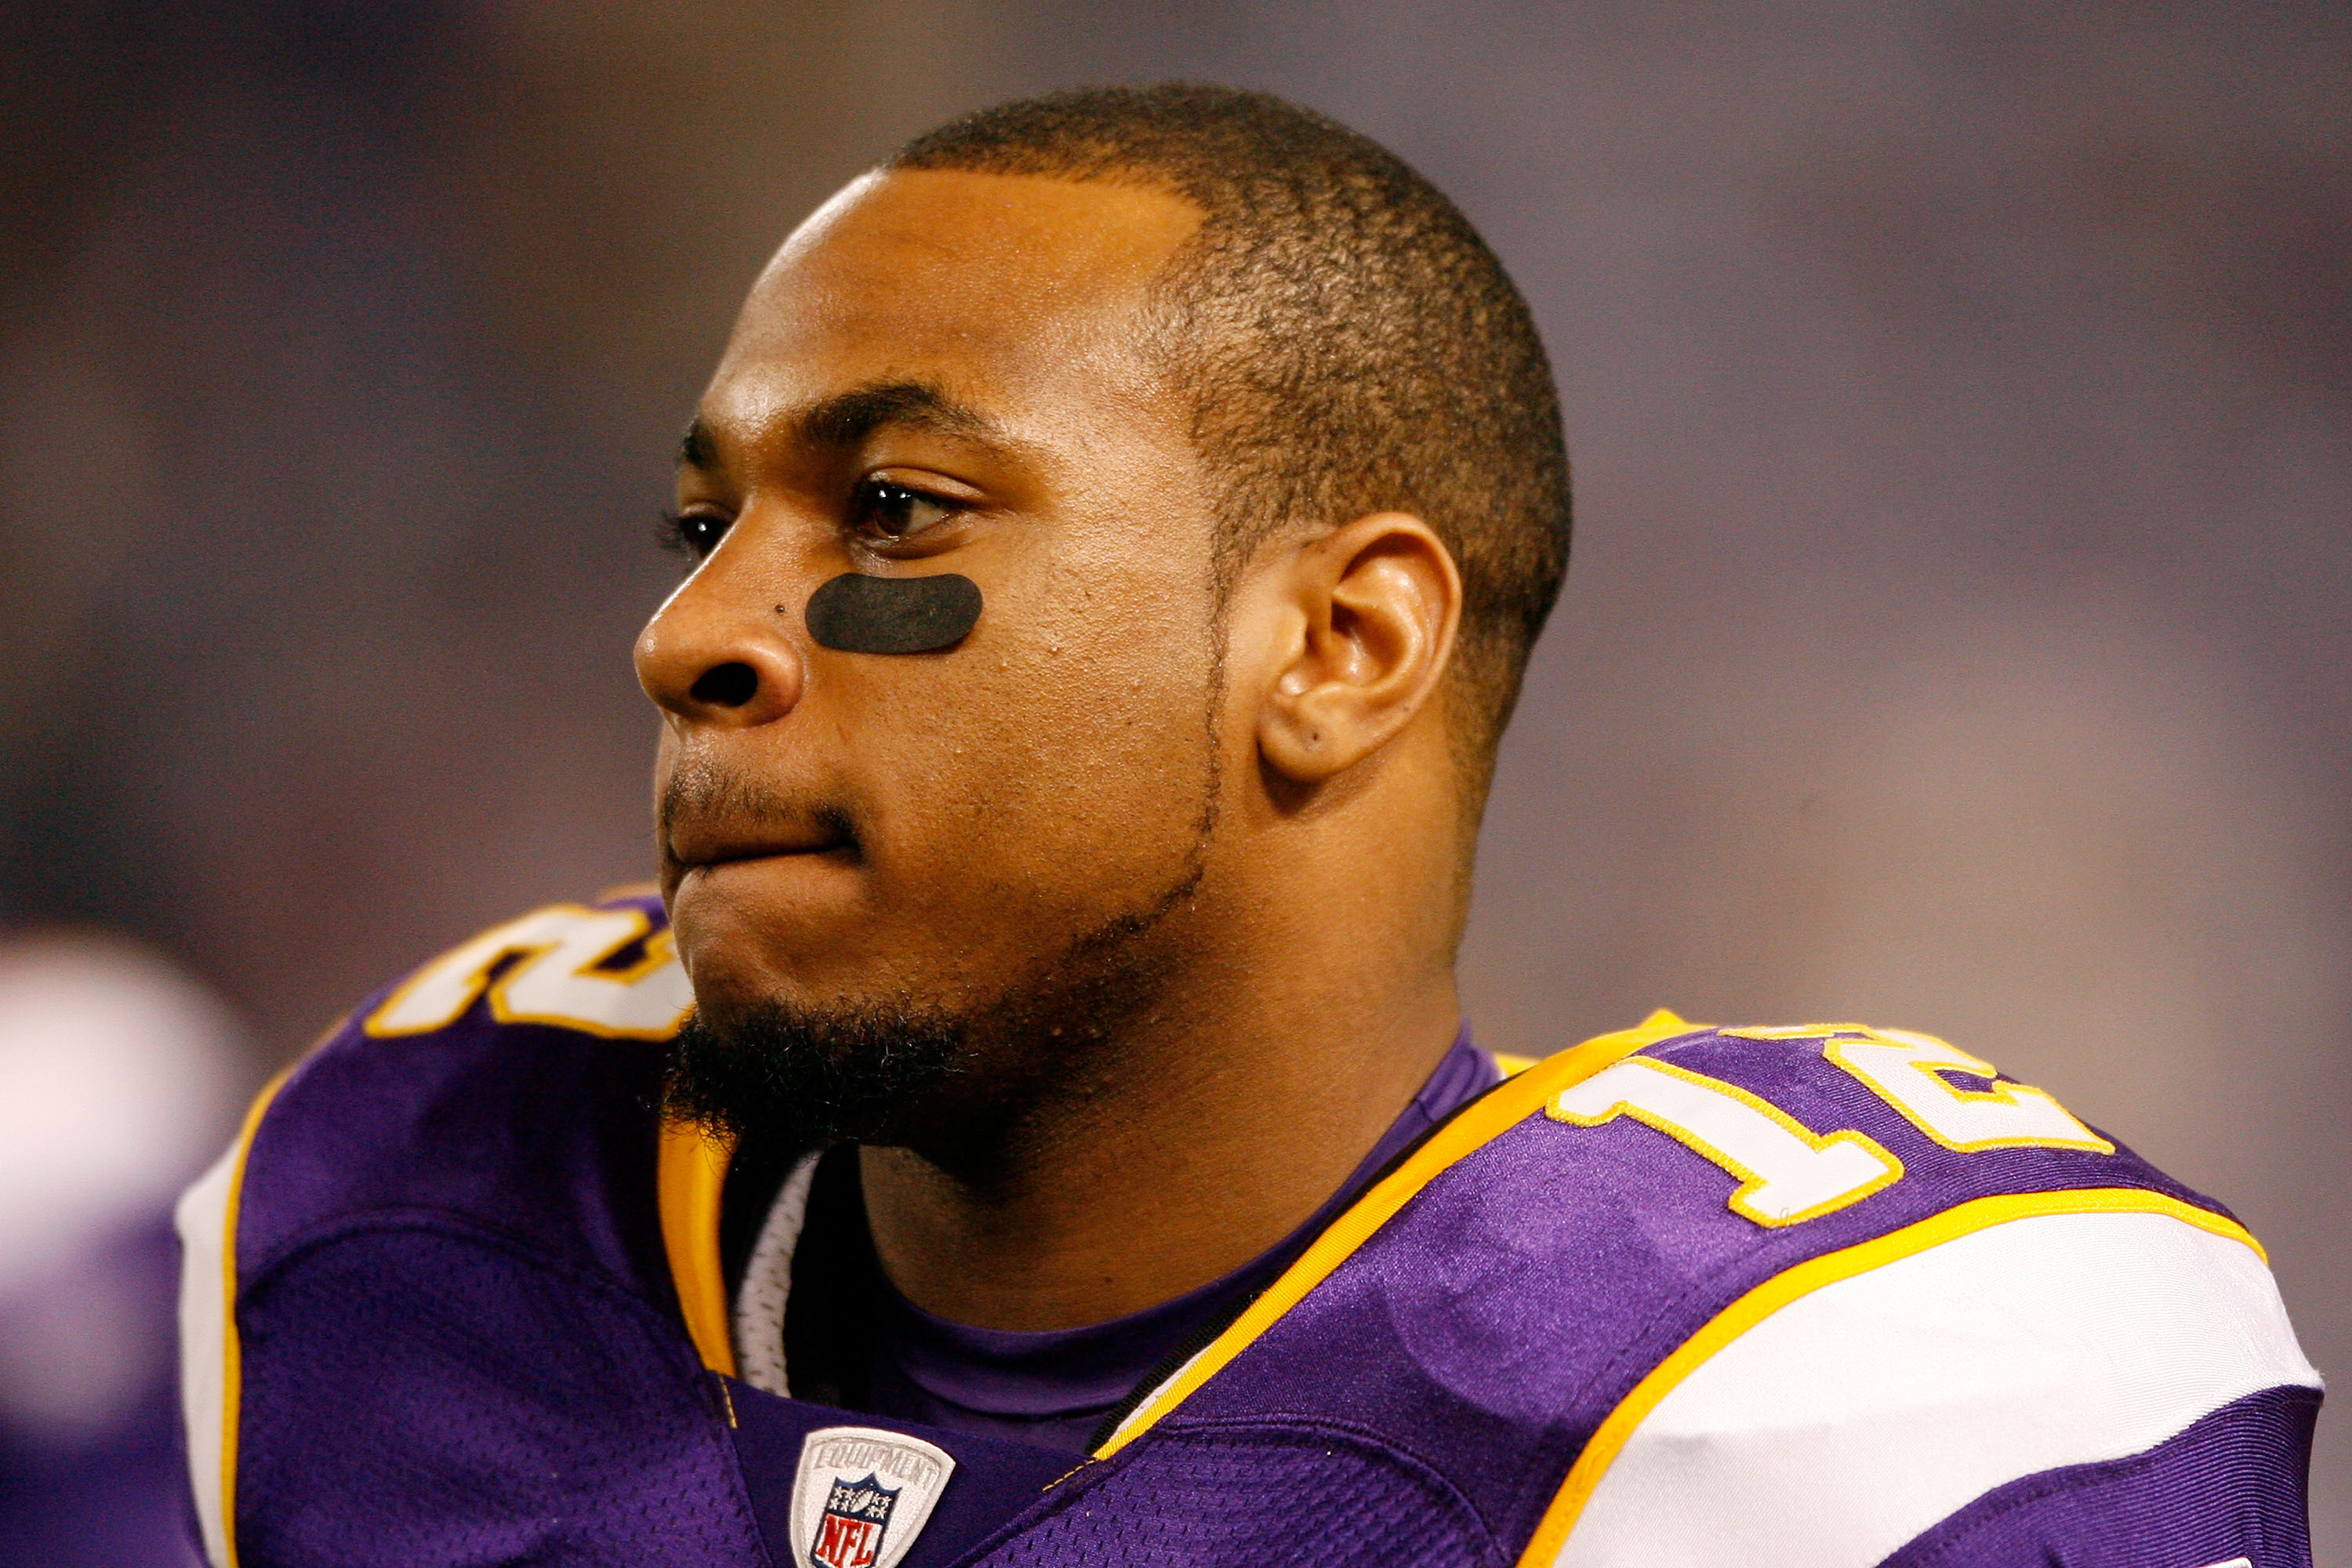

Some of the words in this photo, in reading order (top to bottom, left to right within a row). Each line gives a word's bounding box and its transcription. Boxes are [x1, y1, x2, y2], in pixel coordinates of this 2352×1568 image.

[363, 903, 697, 1041] 2
[813, 1443, 939, 1488] EQUIPMENT
[815, 1514, 876, 1568] NFL
